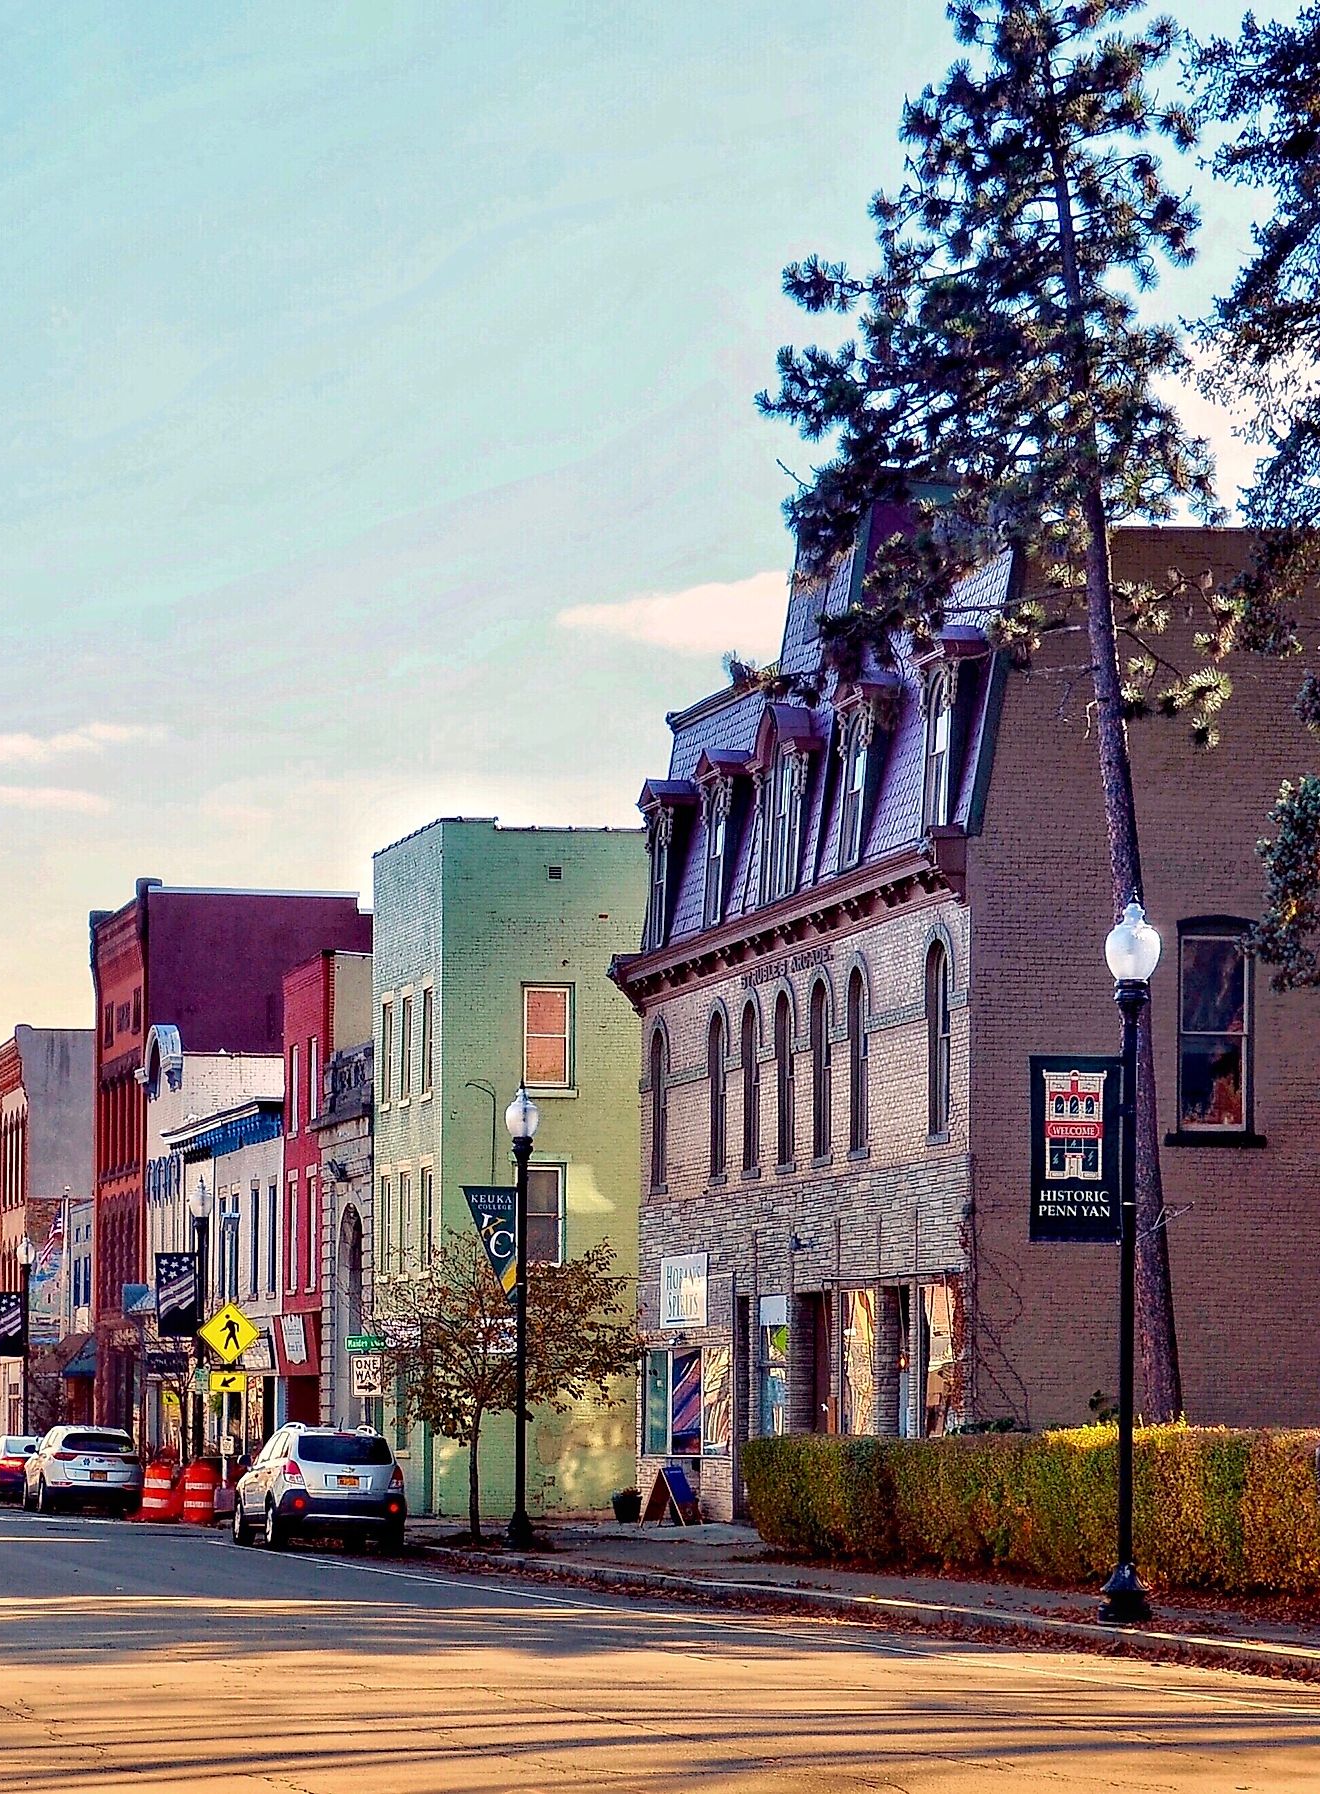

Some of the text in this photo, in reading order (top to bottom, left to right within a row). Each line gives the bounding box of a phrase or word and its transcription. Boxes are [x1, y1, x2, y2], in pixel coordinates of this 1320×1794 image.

[1052, 1126, 1095, 1136] WELCOME
[471, 1194, 512, 1204] KEUKA
[1040, 1190, 1110, 1203] HISTORIC
[1038, 1205, 1111, 1217] PENN YAN
[355, 1360, 378, 1370] ONE
[355, 1370, 379, 1380] WAY
